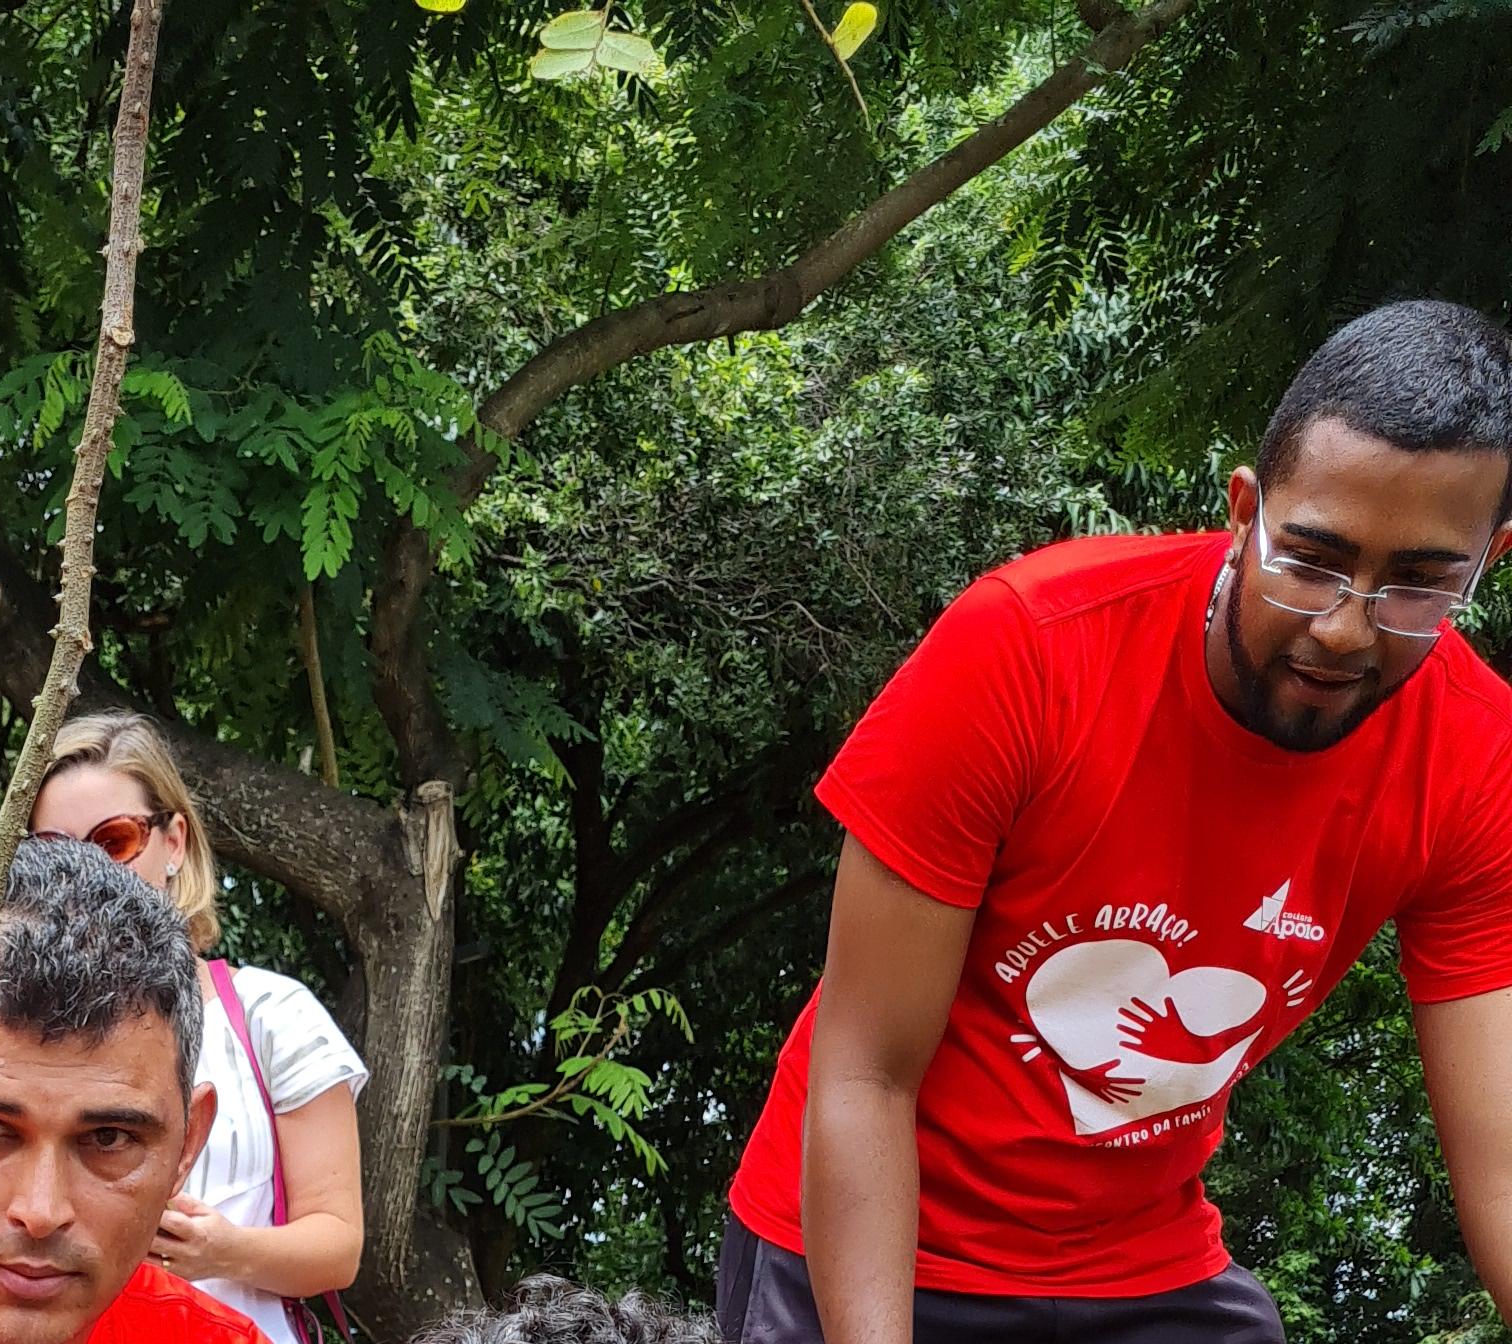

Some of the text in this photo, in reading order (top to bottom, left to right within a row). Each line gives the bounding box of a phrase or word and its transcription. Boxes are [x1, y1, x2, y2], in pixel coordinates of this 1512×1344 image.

[994, 902, 1199, 985] AQUELE ABRAÇO!
[1152, 1118, 1171, 1137] DA
